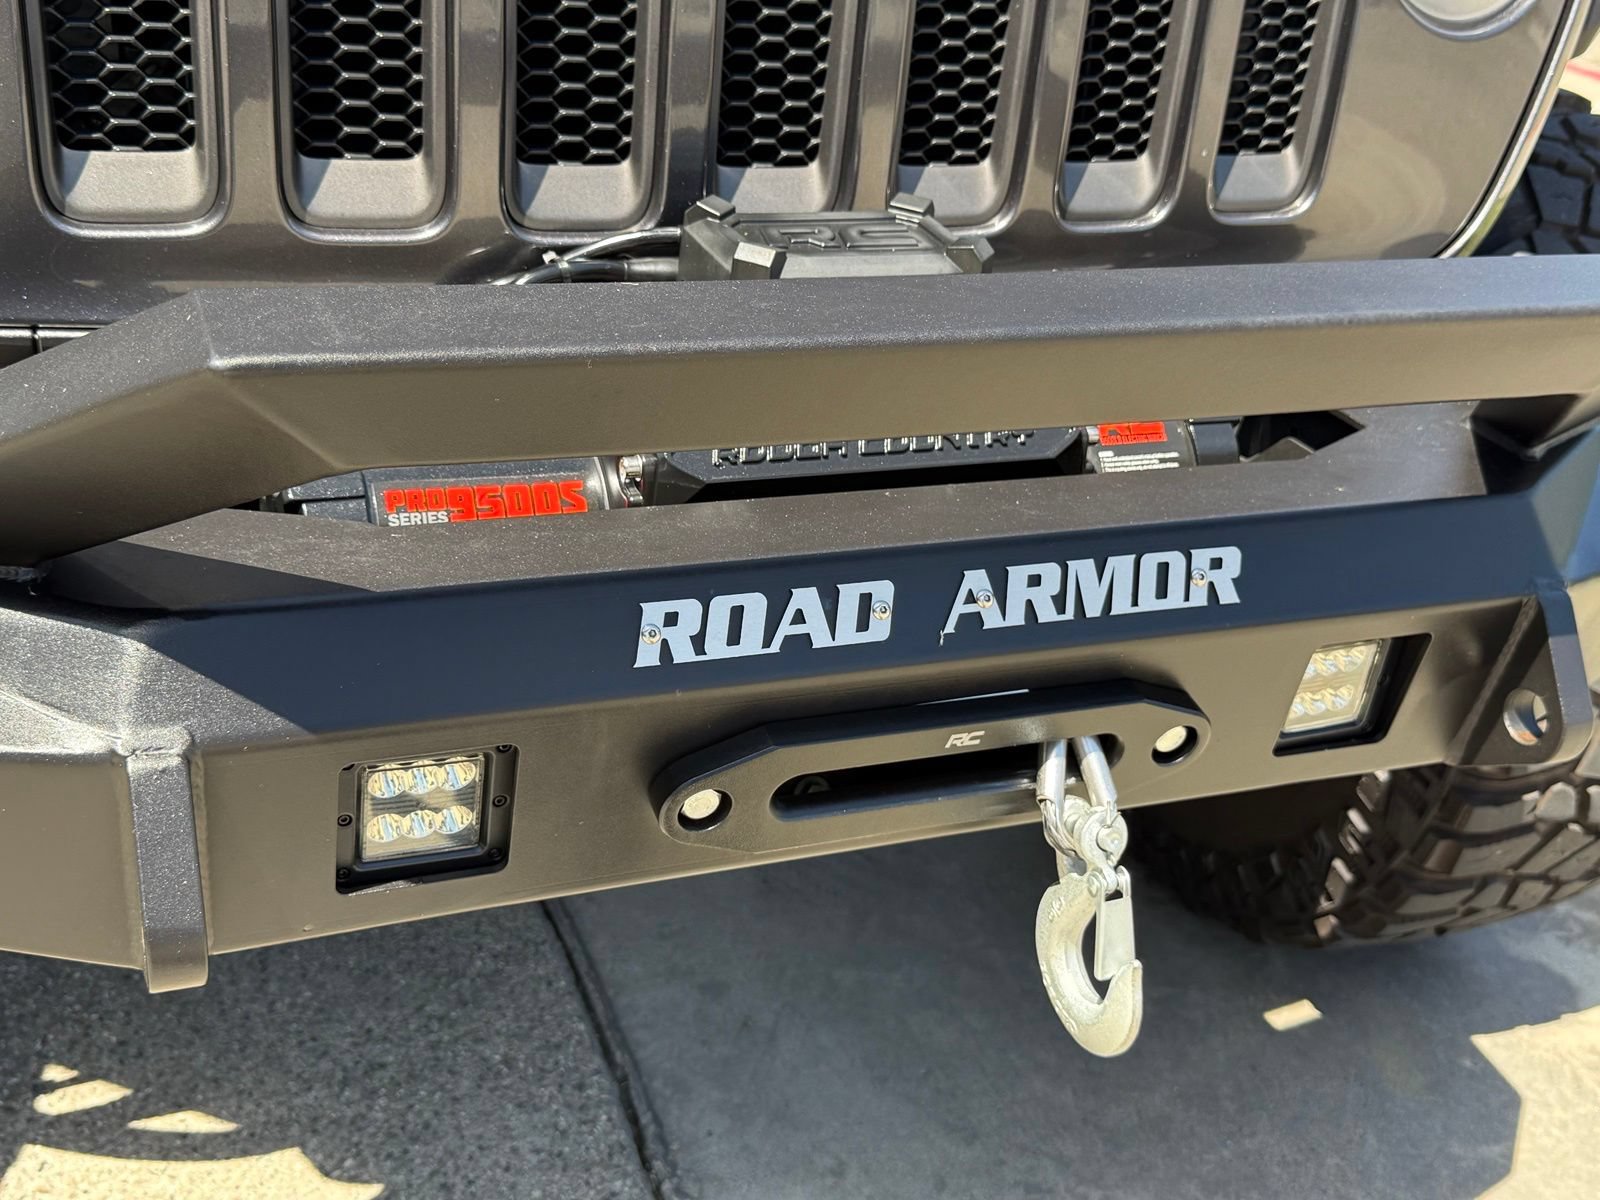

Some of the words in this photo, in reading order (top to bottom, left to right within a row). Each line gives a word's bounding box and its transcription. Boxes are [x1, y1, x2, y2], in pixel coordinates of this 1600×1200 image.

[383, 487, 449, 513] PRO
[446, 479, 588, 523] 9500S
[388, 511, 449, 527] SERIES
[633, 579, 895, 668] ROAD
[940, 545, 1242, 635] ARMOR
[945, 730, 985, 749] RC
